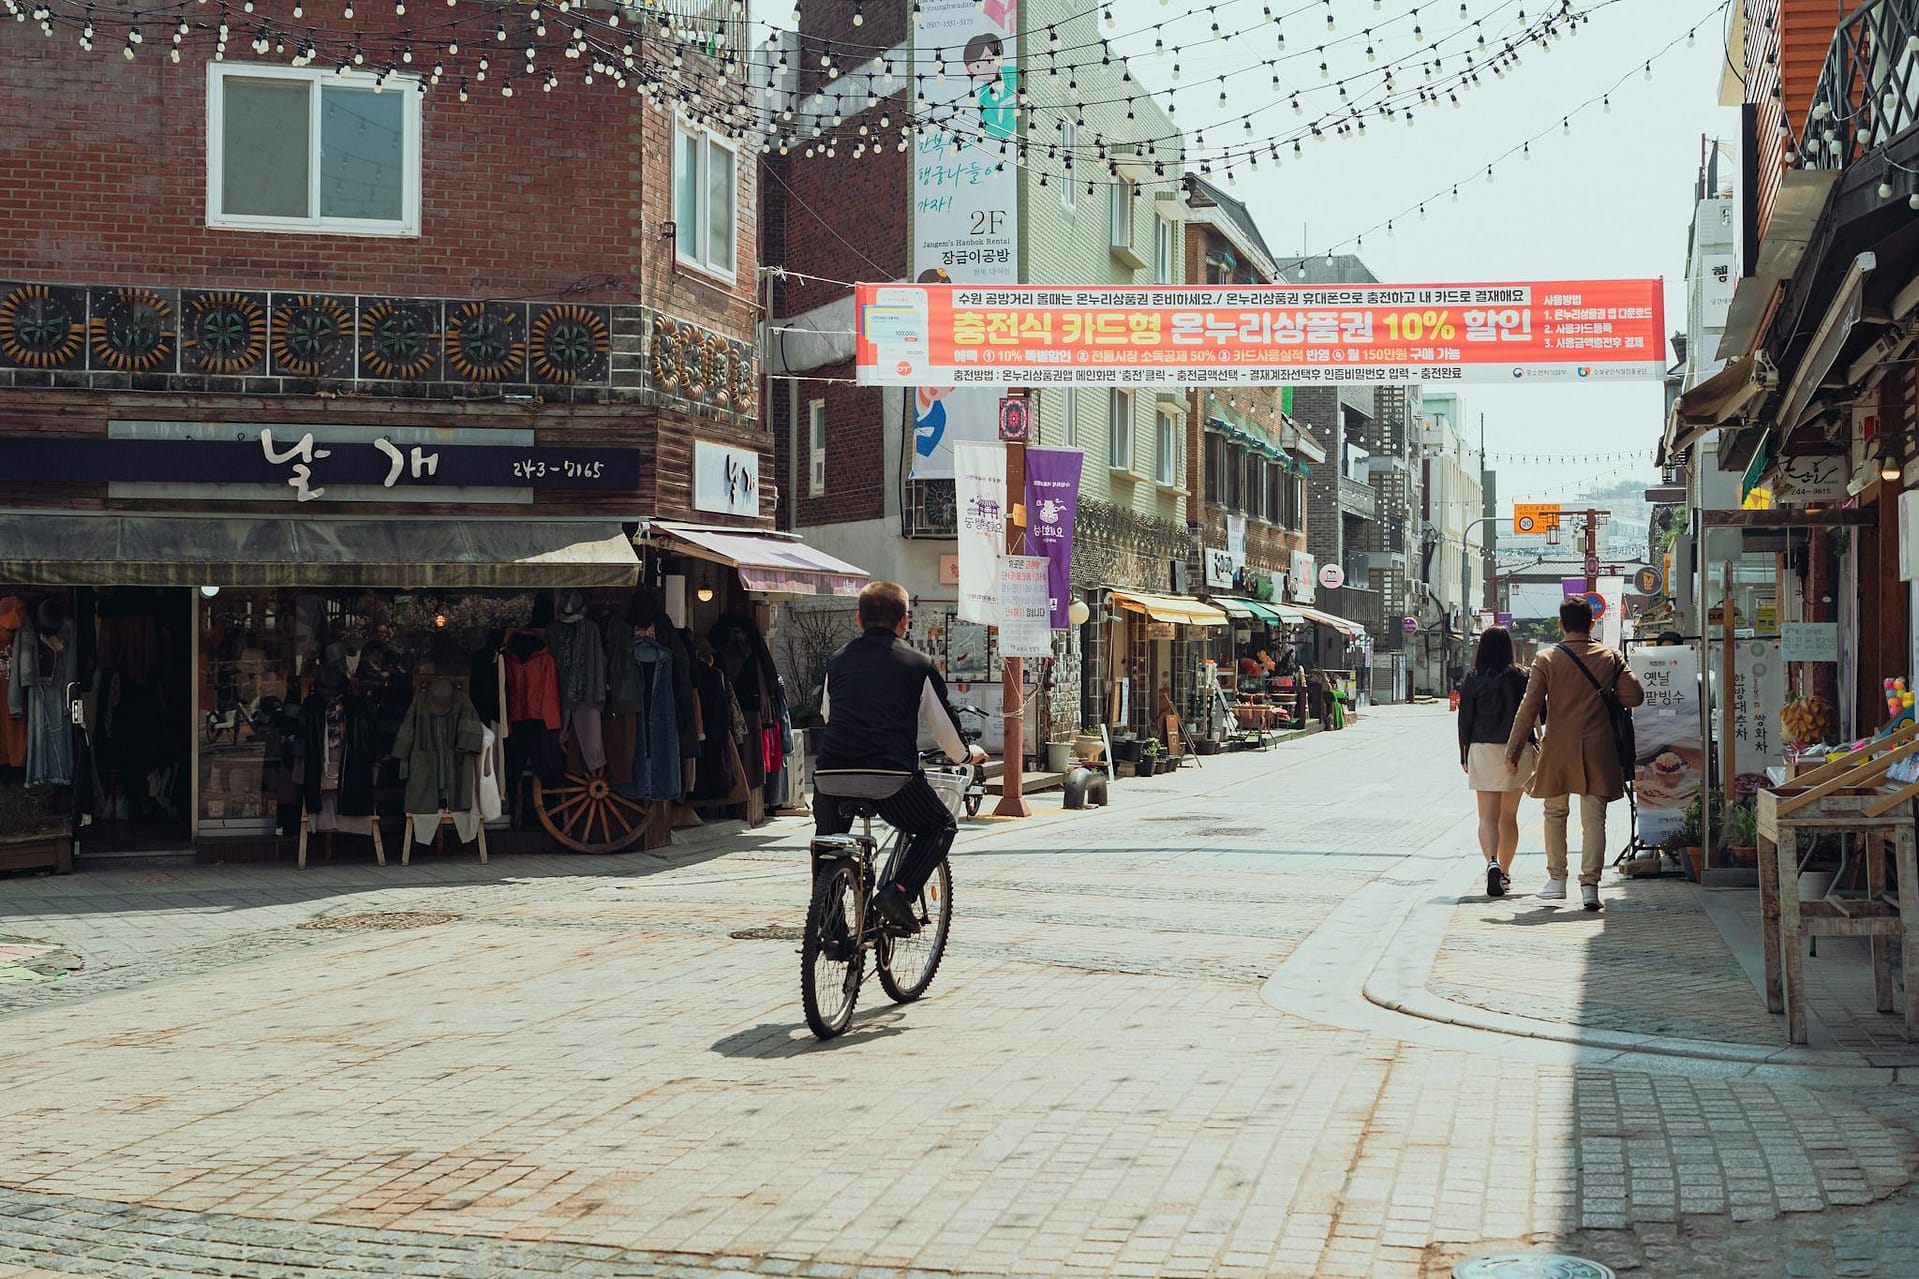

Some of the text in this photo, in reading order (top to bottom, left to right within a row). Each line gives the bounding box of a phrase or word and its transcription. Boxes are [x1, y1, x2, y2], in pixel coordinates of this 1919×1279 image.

[917, 196, 953, 214] 가자!
[970, 210, 1007, 235] 2F
[942, 248, 1010, 265] 장금이공방
[959, 292, 982, 305] 수원
[985, 292, 1033, 305] 공방거리
[1037, 292, 1073, 305] 올때는
[1076, 292, 1148, 305] 온누리상품권
[1226, 292, 1299, 305] 온누리상품권
[1303, 291, 1363, 304] 휴대폰으로
[1367, 291, 1416, 304] 충전하고
[1419, 290, 1431, 303] 내
[1435, 290, 1471, 303] 카드로
[1543, 294, 1582, 306] 사용방법
[1554, 308, 1606, 321] 온누리상품권
[1618, 307, 1653, 319] 다운로드
[953, 308, 1533, 345] 충전식 카드형 온누리상품권 10% 할인
[997, 349, 1022, 362] 10%
[1092, 349, 1137, 363] 전통시장
[1140, 349, 1187, 363] 소득공제
[1190, 349, 1216, 362] 50%
[1233, 349, 1303, 363] 카드사용실적
[1306, 348, 1330, 362] 반영
[1363, 348, 1407, 361] 150만원
[1410, 347, 1433, 361] 구매
[1436, 347, 1461, 360] 가능
[953, 369, 993, 382] 충전방법
[1002, 369, 1073, 382] 온누리상품권앱
[1075, 369, 1116, 382] 메인화면
[1177, 369, 1238, 381] 충전금액선택
[1324, 368, 1385, 381] 인증비밀번호
[1388, 368, 1409, 380] 입력
[1420, 367, 1462, 379] 충전완료
[513, 459, 605, 479] 243-7165
[1643, 671, 1671, 687] 옛날
[1645, 690, 1685, 707] 팥빙수
[1754, 713, 1768, 755] 쌍화차
